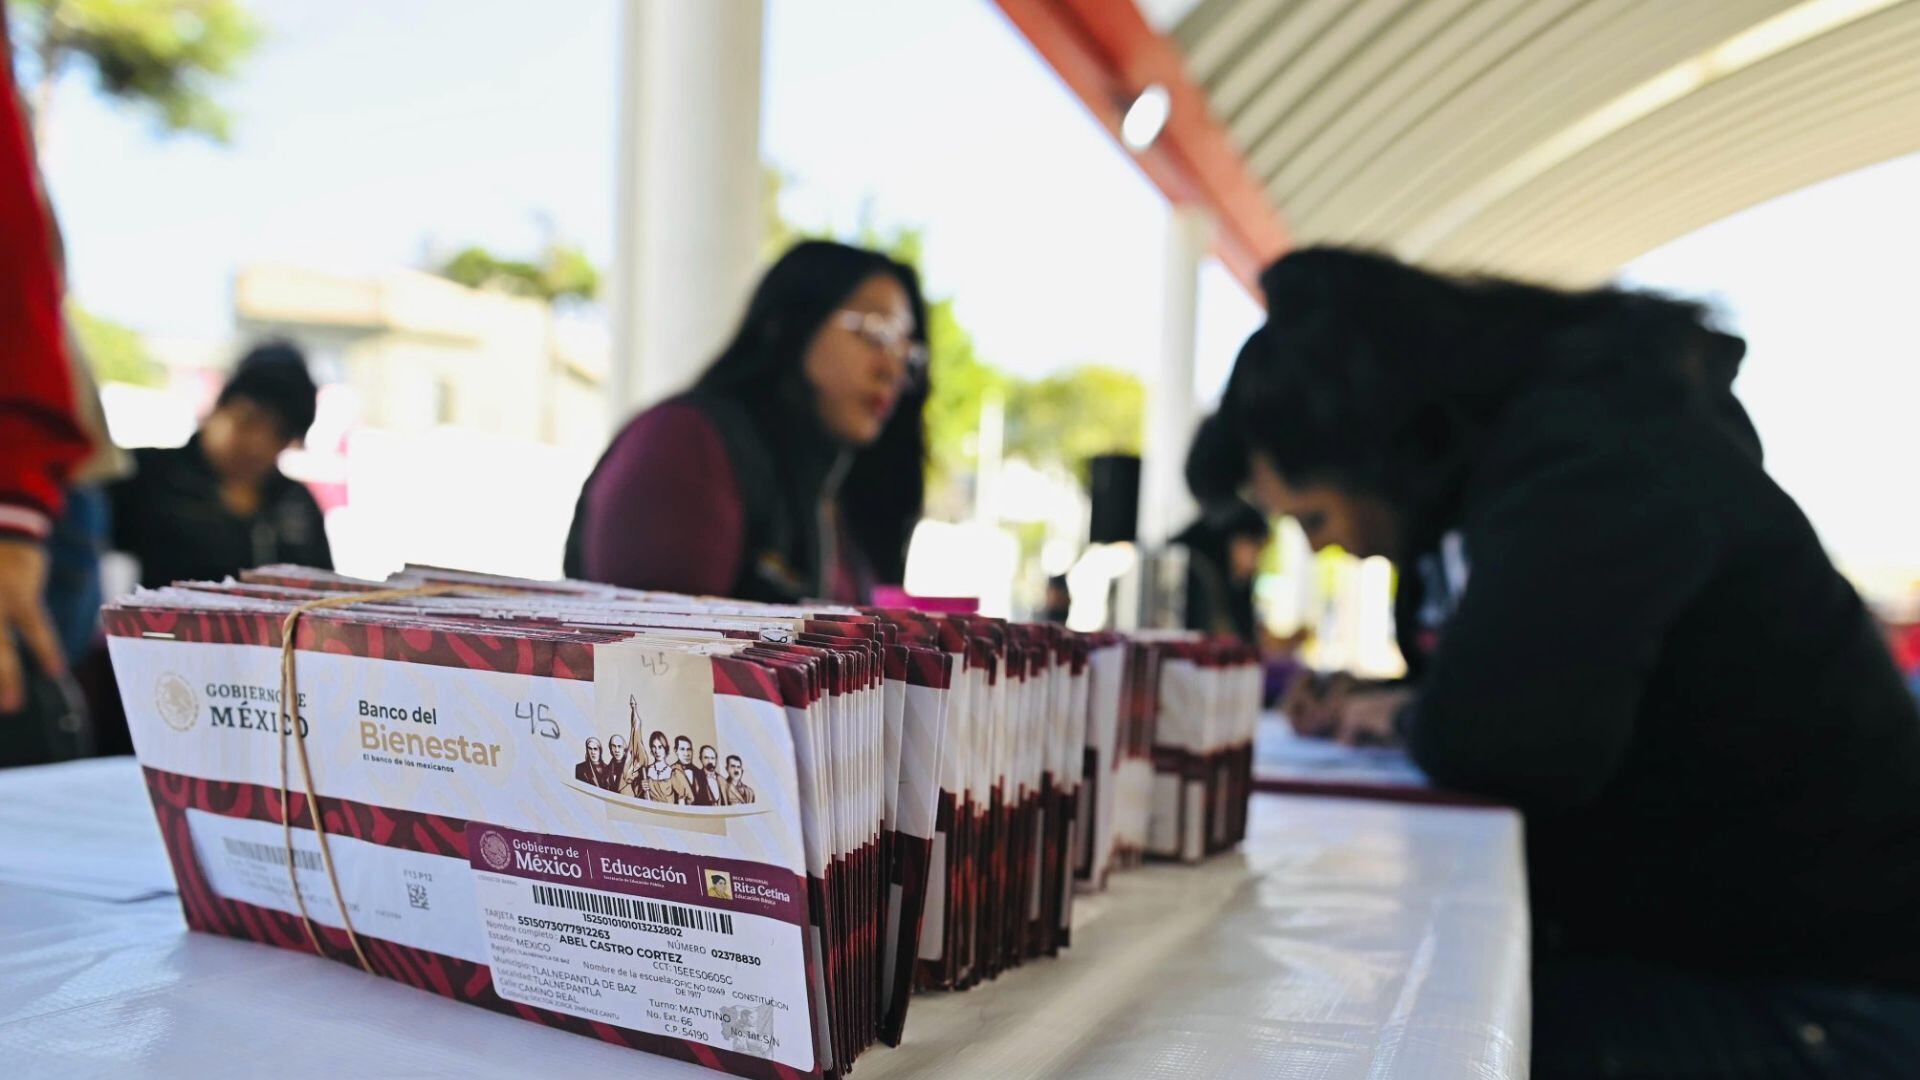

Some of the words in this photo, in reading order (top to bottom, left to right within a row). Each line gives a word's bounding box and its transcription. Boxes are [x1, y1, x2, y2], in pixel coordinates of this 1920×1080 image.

[641, 652, 669, 677] 45
[210, 701, 309, 739] MÉXICO
[359, 700, 408, 721] Banco
[412, 706, 437, 725] del
[515, 702, 560, 740] 45
[360, 720, 501, 767] Bienestar
[362, 753, 370, 761] El
[371, 754, 392, 764] banco
[404, 758, 415, 767] los
[416, 762, 455, 773] mexicanos
[512, 838, 563, 857] Gobierno
[566, 846, 580, 859] de
[515, 850, 582, 879] México
[600, 857, 688, 885] Educación
[733, 881, 756, 895] Rita
[757, 885, 790, 903] Cetina
[735, 893, 760, 902] Educación
[485, 908, 515, 920] TARJETA
[517, 915, 610, 940] 5515073077912263
[582, 913, 683, 937] 1525010101013232802
[486, 920, 516, 932] Nombre
[559, 934, 588, 949] ABEL
[590, 939, 634, 956] CASTRO
[636, 948, 683, 964] CORTEZ
[667, 939, 706, 955] NÚMERO
[711, 949, 761, 966] 02378830
[582, 961, 615, 976] Nombre
[617, 967, 628, 977] de
[629, 969, 638, 979] la
[674, 979, 692, 989] OFIC
[693, 983, 706, 992] NO
[652, 961, 672, 972] CCT:
[531, 965, 600, 987] TLALNEPANTLA
[601, 979, 615, 991] DE
[617, 982, 638, 995] BAZ
[532, 975, 602, 998] TLALNEPANTLA
[675, 988, 686, 997] DE
[519, 983, 554, 998] CAMINO
[555, 991, 579, 1004] REAL
[646, 1009, 661, 1021] No.
[663, 1011, 680, 1023] Ext.
[680, 1016, 693, 1027] 66
[649, 998, 678, 1011] Turno:
[679, 1004, 731, 1023] MATUTINO
[682, 1028, 709, 1041] 54190
[730, 1026, 746, 1038] No.
